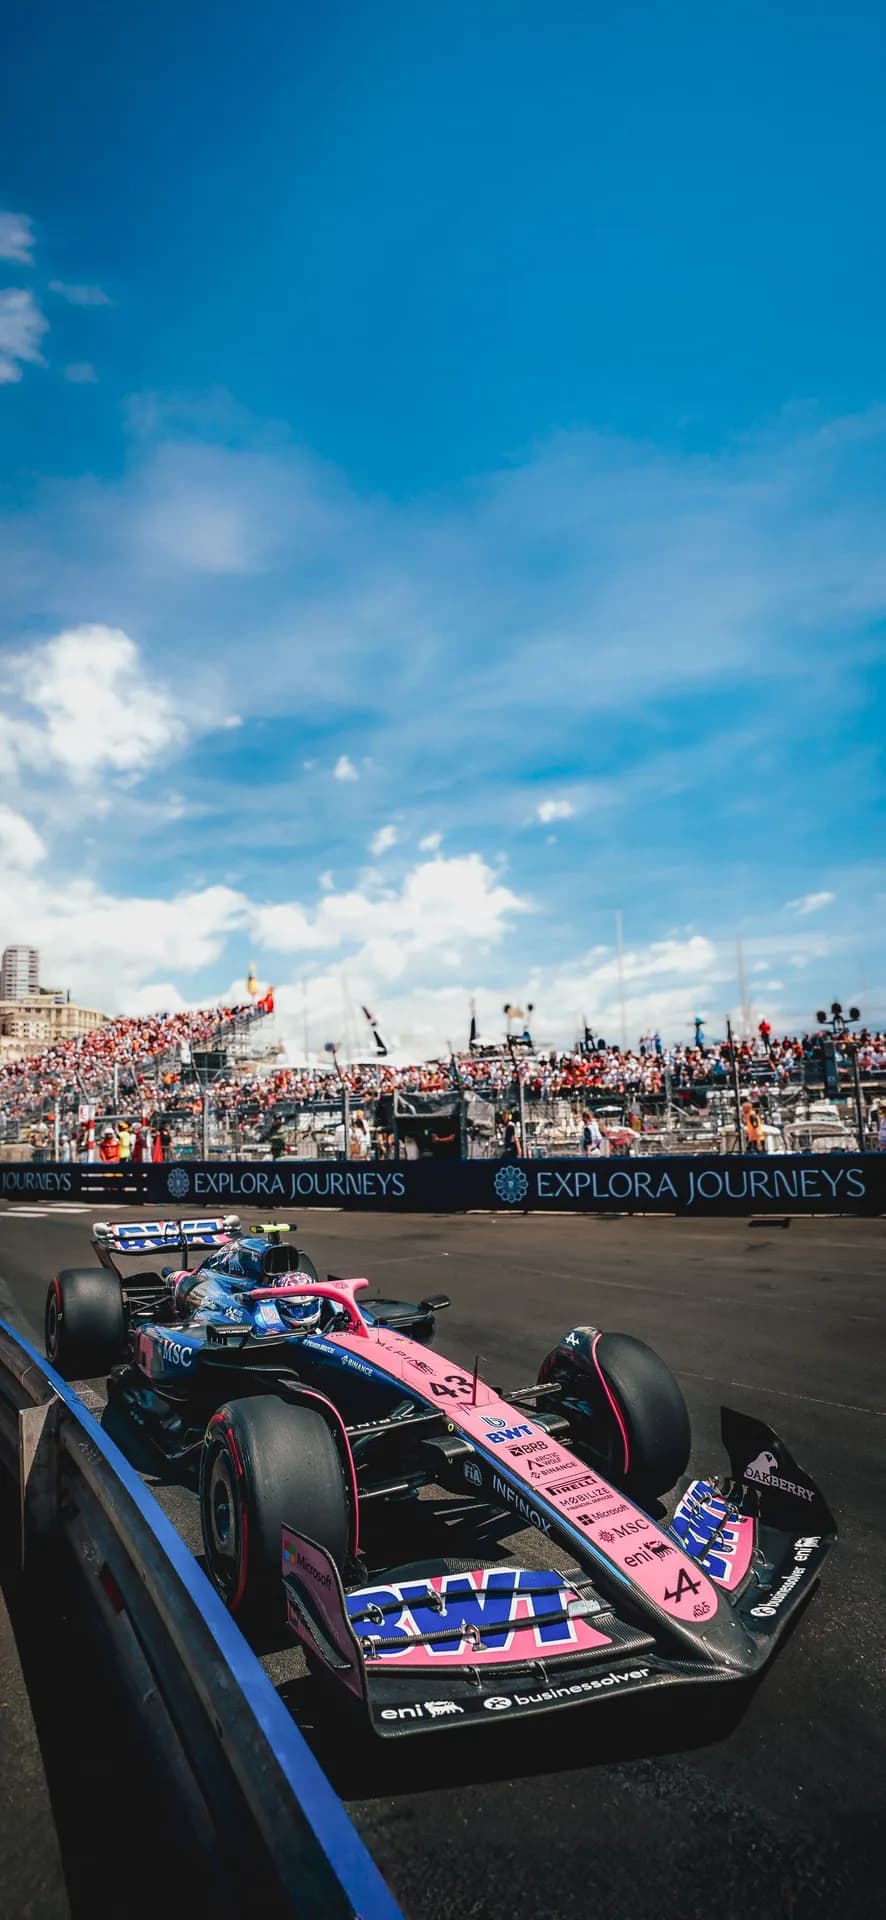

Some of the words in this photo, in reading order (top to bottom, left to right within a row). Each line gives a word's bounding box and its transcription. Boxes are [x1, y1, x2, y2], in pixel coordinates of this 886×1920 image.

[2, 1171, 72, 1192] JOURNEYS
[194, 1173, 285, 1195] EXPLORA
[290, 1172, 406, 1200] JOURNEYS
[537, 1171, 678, 1199] EXPLORA
[686, 1168, 866, 1205] JOURNEYS
[162, 1340, 193, 1367] MSC
[347, 1358, 374, 1377] BINANCE
[429, 1375, 474, 1399] 43
[485, 1424, 533, 1445] BWT
[523, 1440, 549, 1455] BRB
[535, 1452, 560, 1463] ARCTIC
[541, 1461, 578, 1476] BINANCE
[542, 1457, 563, 1467] WOLF
[545, 1475, 598, 1496] PIRELLI
[743, 1466, 816, 1501] OAKBERRY
[492, 1474, 553, 1538] INFINOX
[591, 1503, 630, 1521] Microsoft
[612, 1518, 650, 1539] MSC
[624, 1546, 652, 1568] eni
[794, 1544, 813, 1562] eni
[297, 1553, 332, 1592] Microsoft
[344, 1570, 578, 1657] BWT
[380, 1704, 424, 1720] eni
[514, 1667, 650, 1706] businessolver
